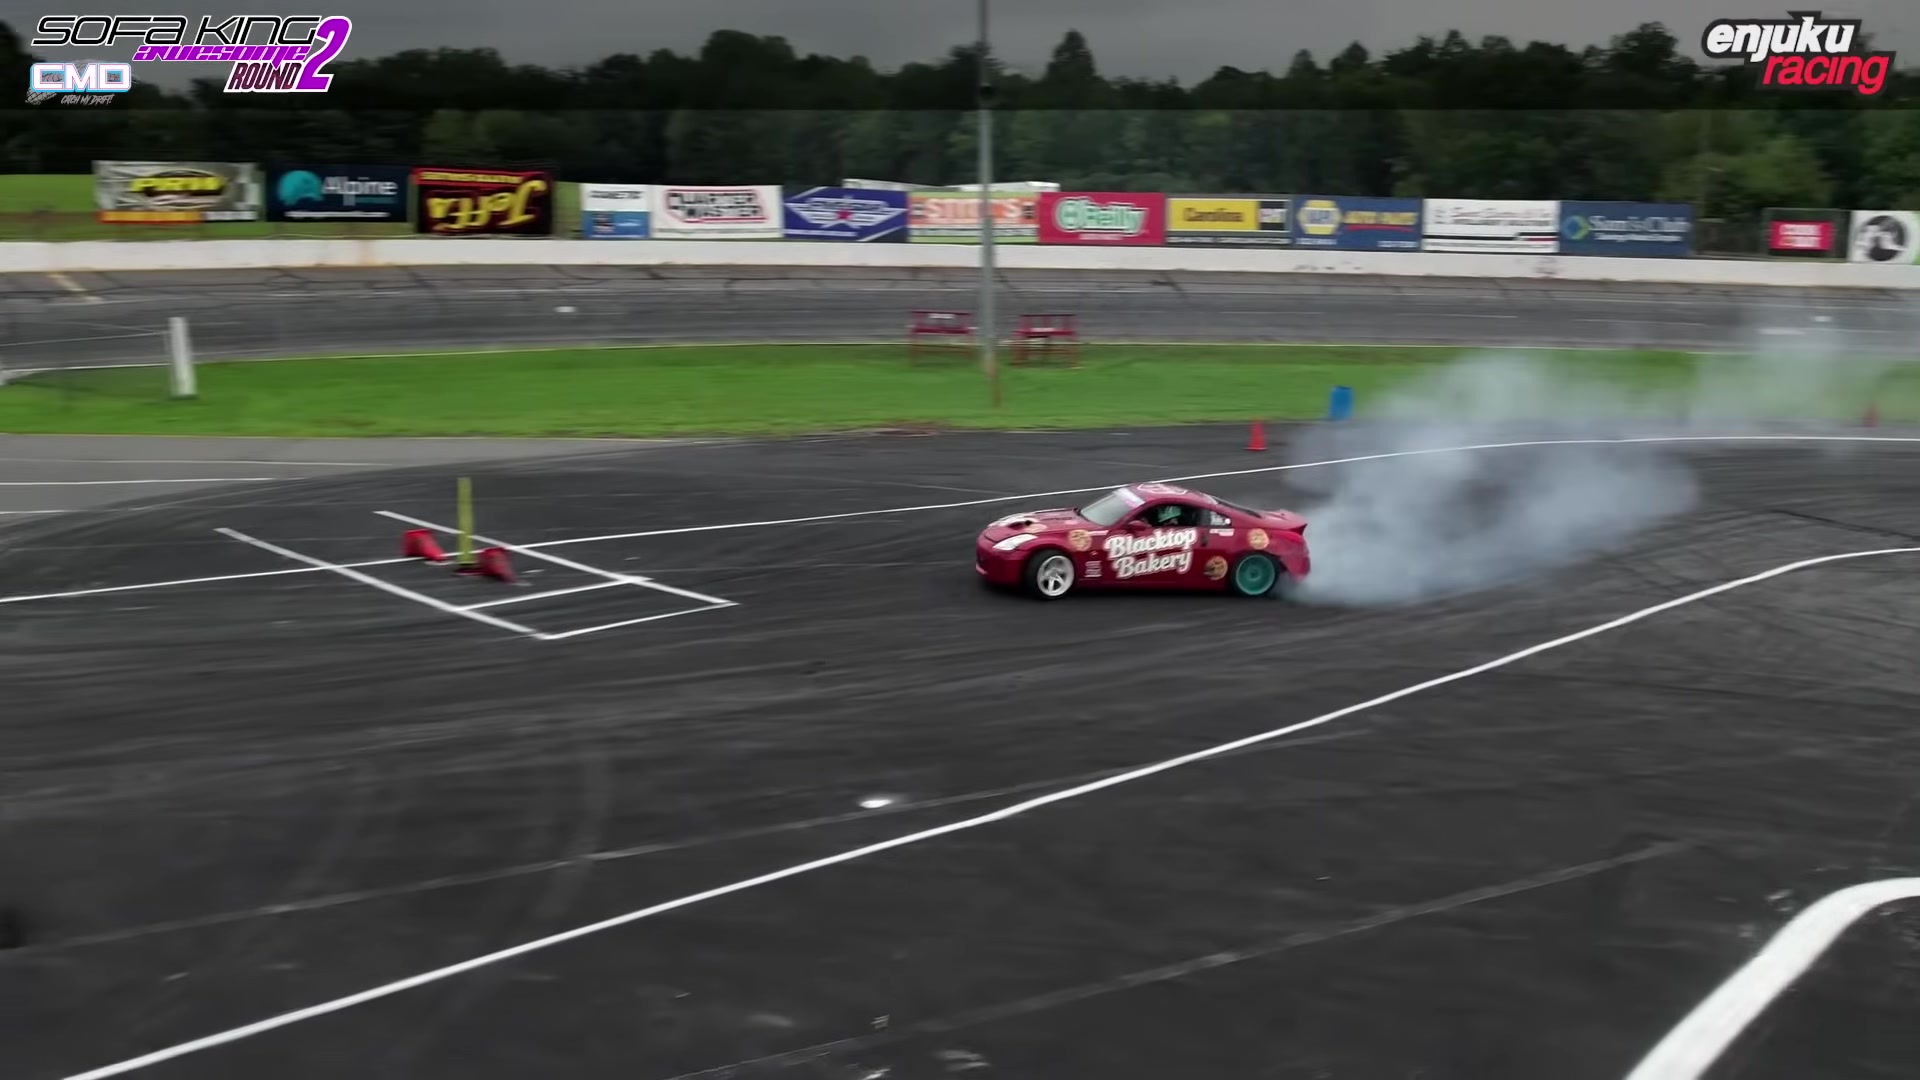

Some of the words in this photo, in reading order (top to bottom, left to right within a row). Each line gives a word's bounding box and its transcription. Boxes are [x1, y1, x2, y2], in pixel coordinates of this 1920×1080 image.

[322, 176, 398, 206] Alpine
[1104, 527, 1198, 560] Blacktop
[1111, 550, 1192, 580] Bakery
